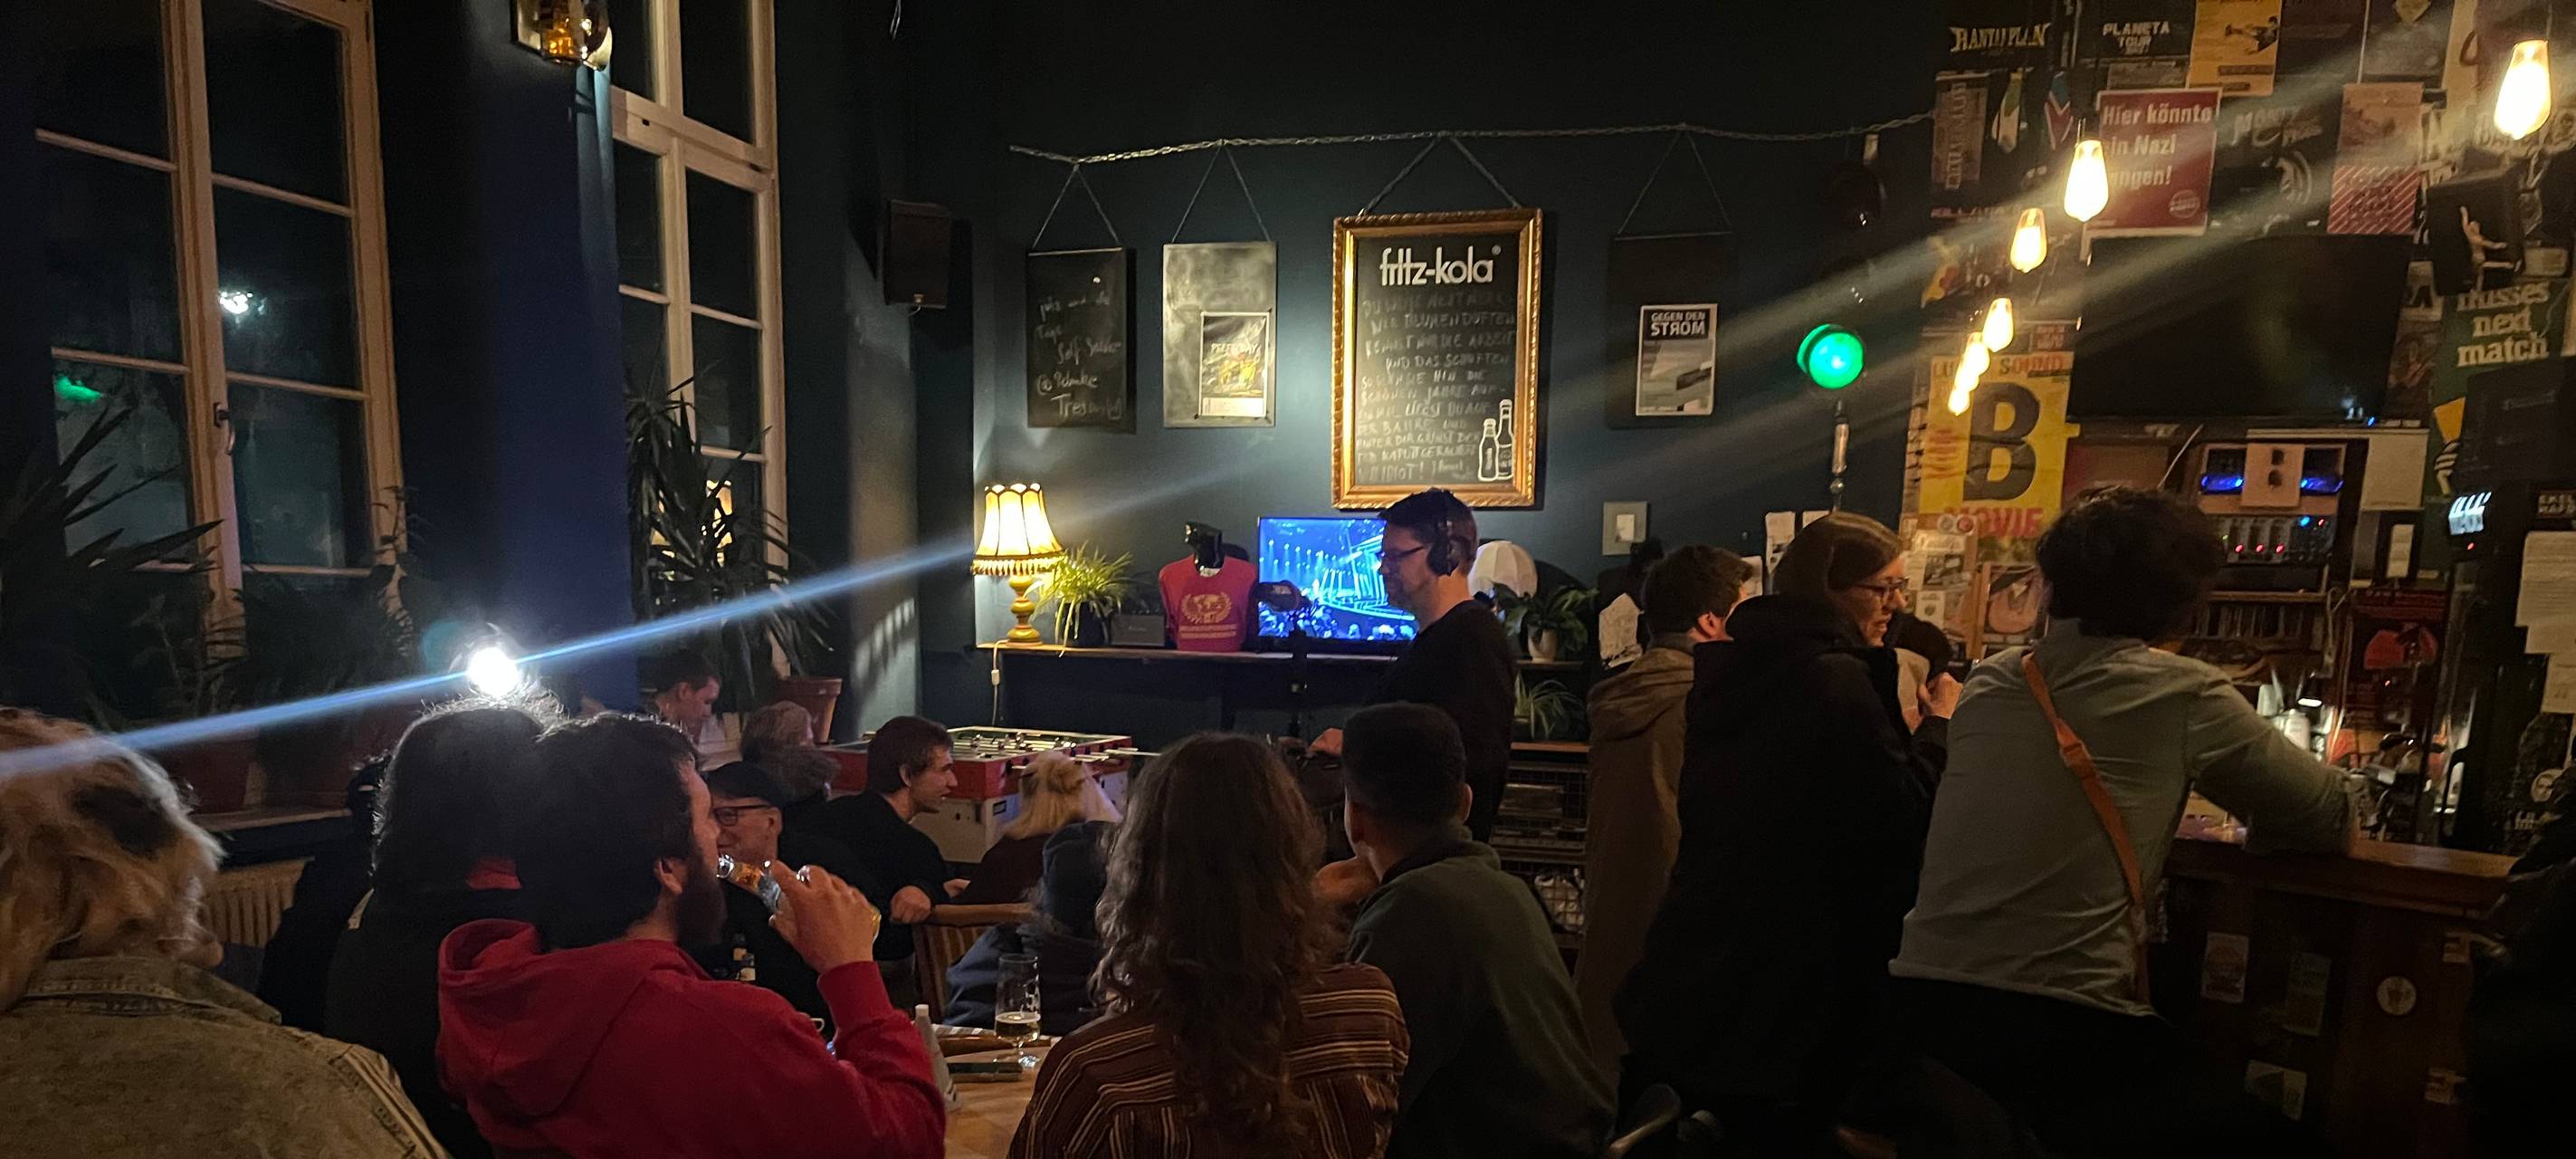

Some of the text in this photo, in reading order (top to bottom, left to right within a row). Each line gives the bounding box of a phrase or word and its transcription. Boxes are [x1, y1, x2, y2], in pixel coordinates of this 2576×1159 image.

[2103, 21, 2170, 36] PLANETA
[2103, 102, 2212, 125] Hier könnte
[2105, 132, 2178, 156] in Nazi
[2112, 165, 2173, 189] ngen!
[1651, 311, 1706, 321] GEGEN DEN
[2472, 305, 2532, 338] next
[1650, 321, 1706, 336] STROM
[2457, 331, 2550, 369] match
[1962, 381, 2041, 502] B
[1944, 506, 2044, 539] OVIE
